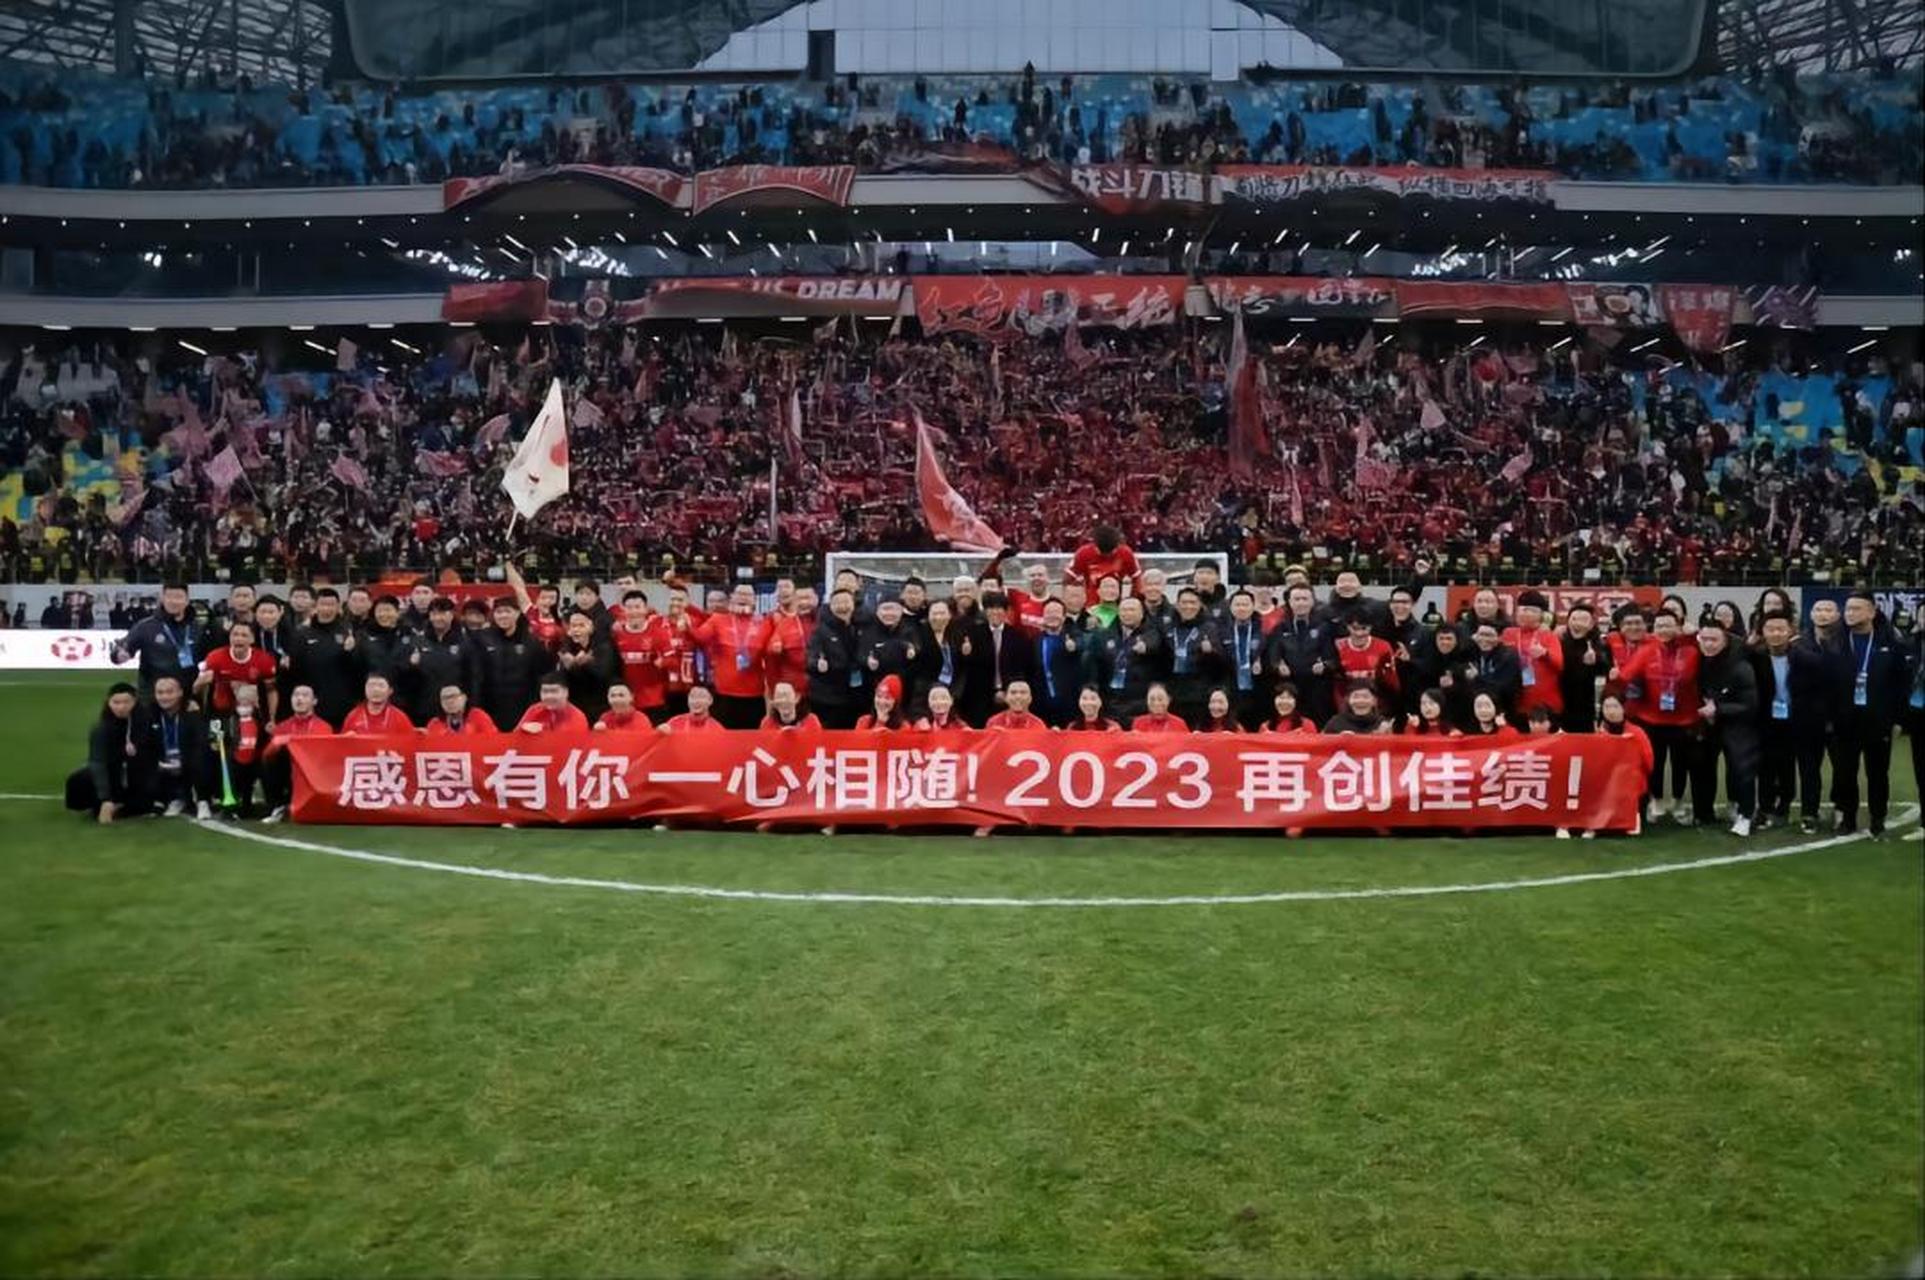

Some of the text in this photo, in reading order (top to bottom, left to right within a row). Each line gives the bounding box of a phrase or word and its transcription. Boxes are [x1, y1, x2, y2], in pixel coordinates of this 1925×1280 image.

[796, 279, 901, 301] DREAM
[338, 747, 1582, 811] 感恩有你 一心相随! 2023 再创佳绩!
